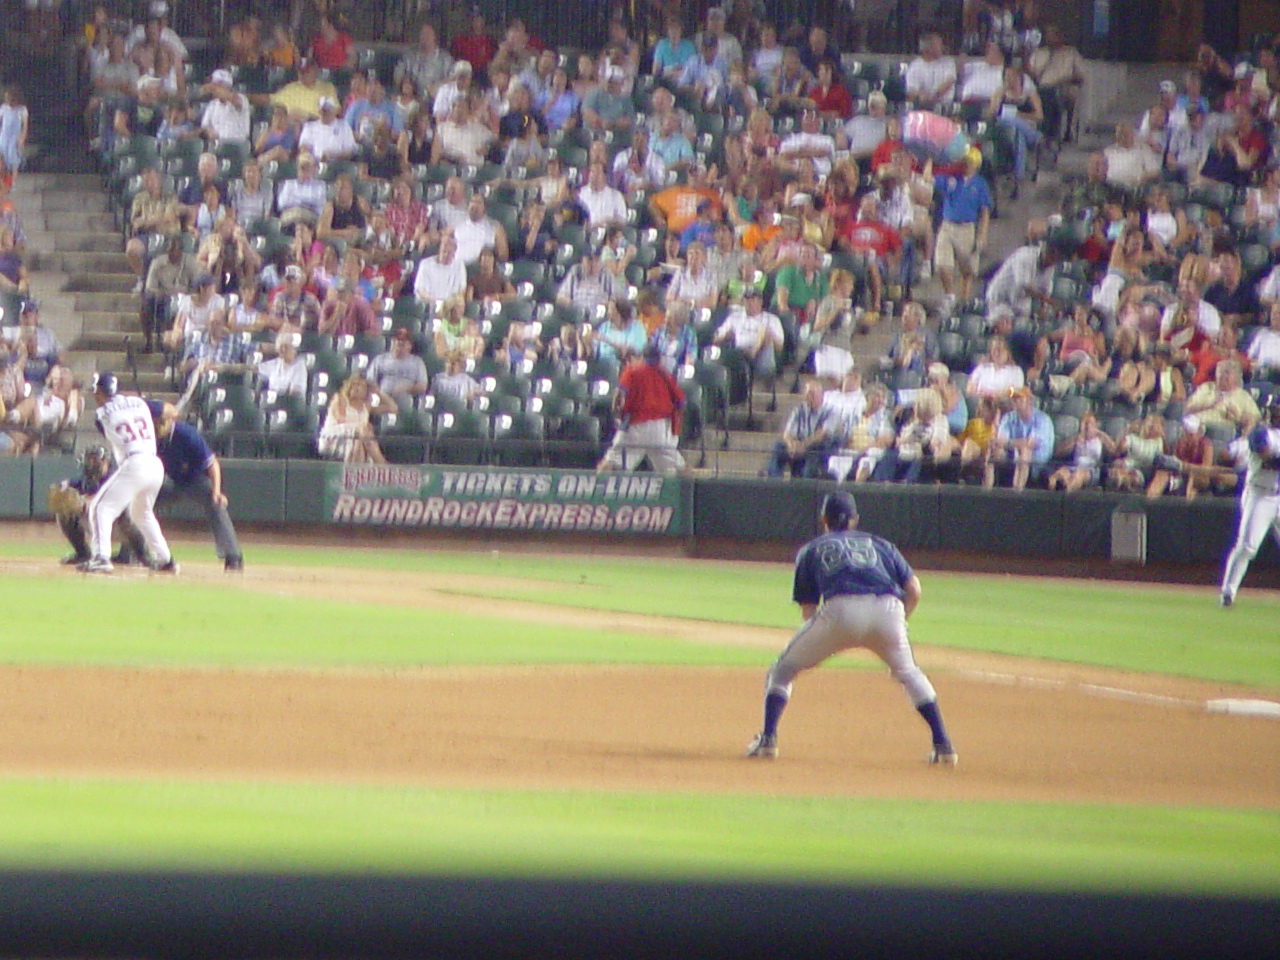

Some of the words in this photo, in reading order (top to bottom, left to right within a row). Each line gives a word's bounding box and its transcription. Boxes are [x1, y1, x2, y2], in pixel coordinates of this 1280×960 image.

[115, 416, 151, 443] 32
[441, 471, 551, 494] TICKETS
[557, 474, 664, 500] ON-LINE
